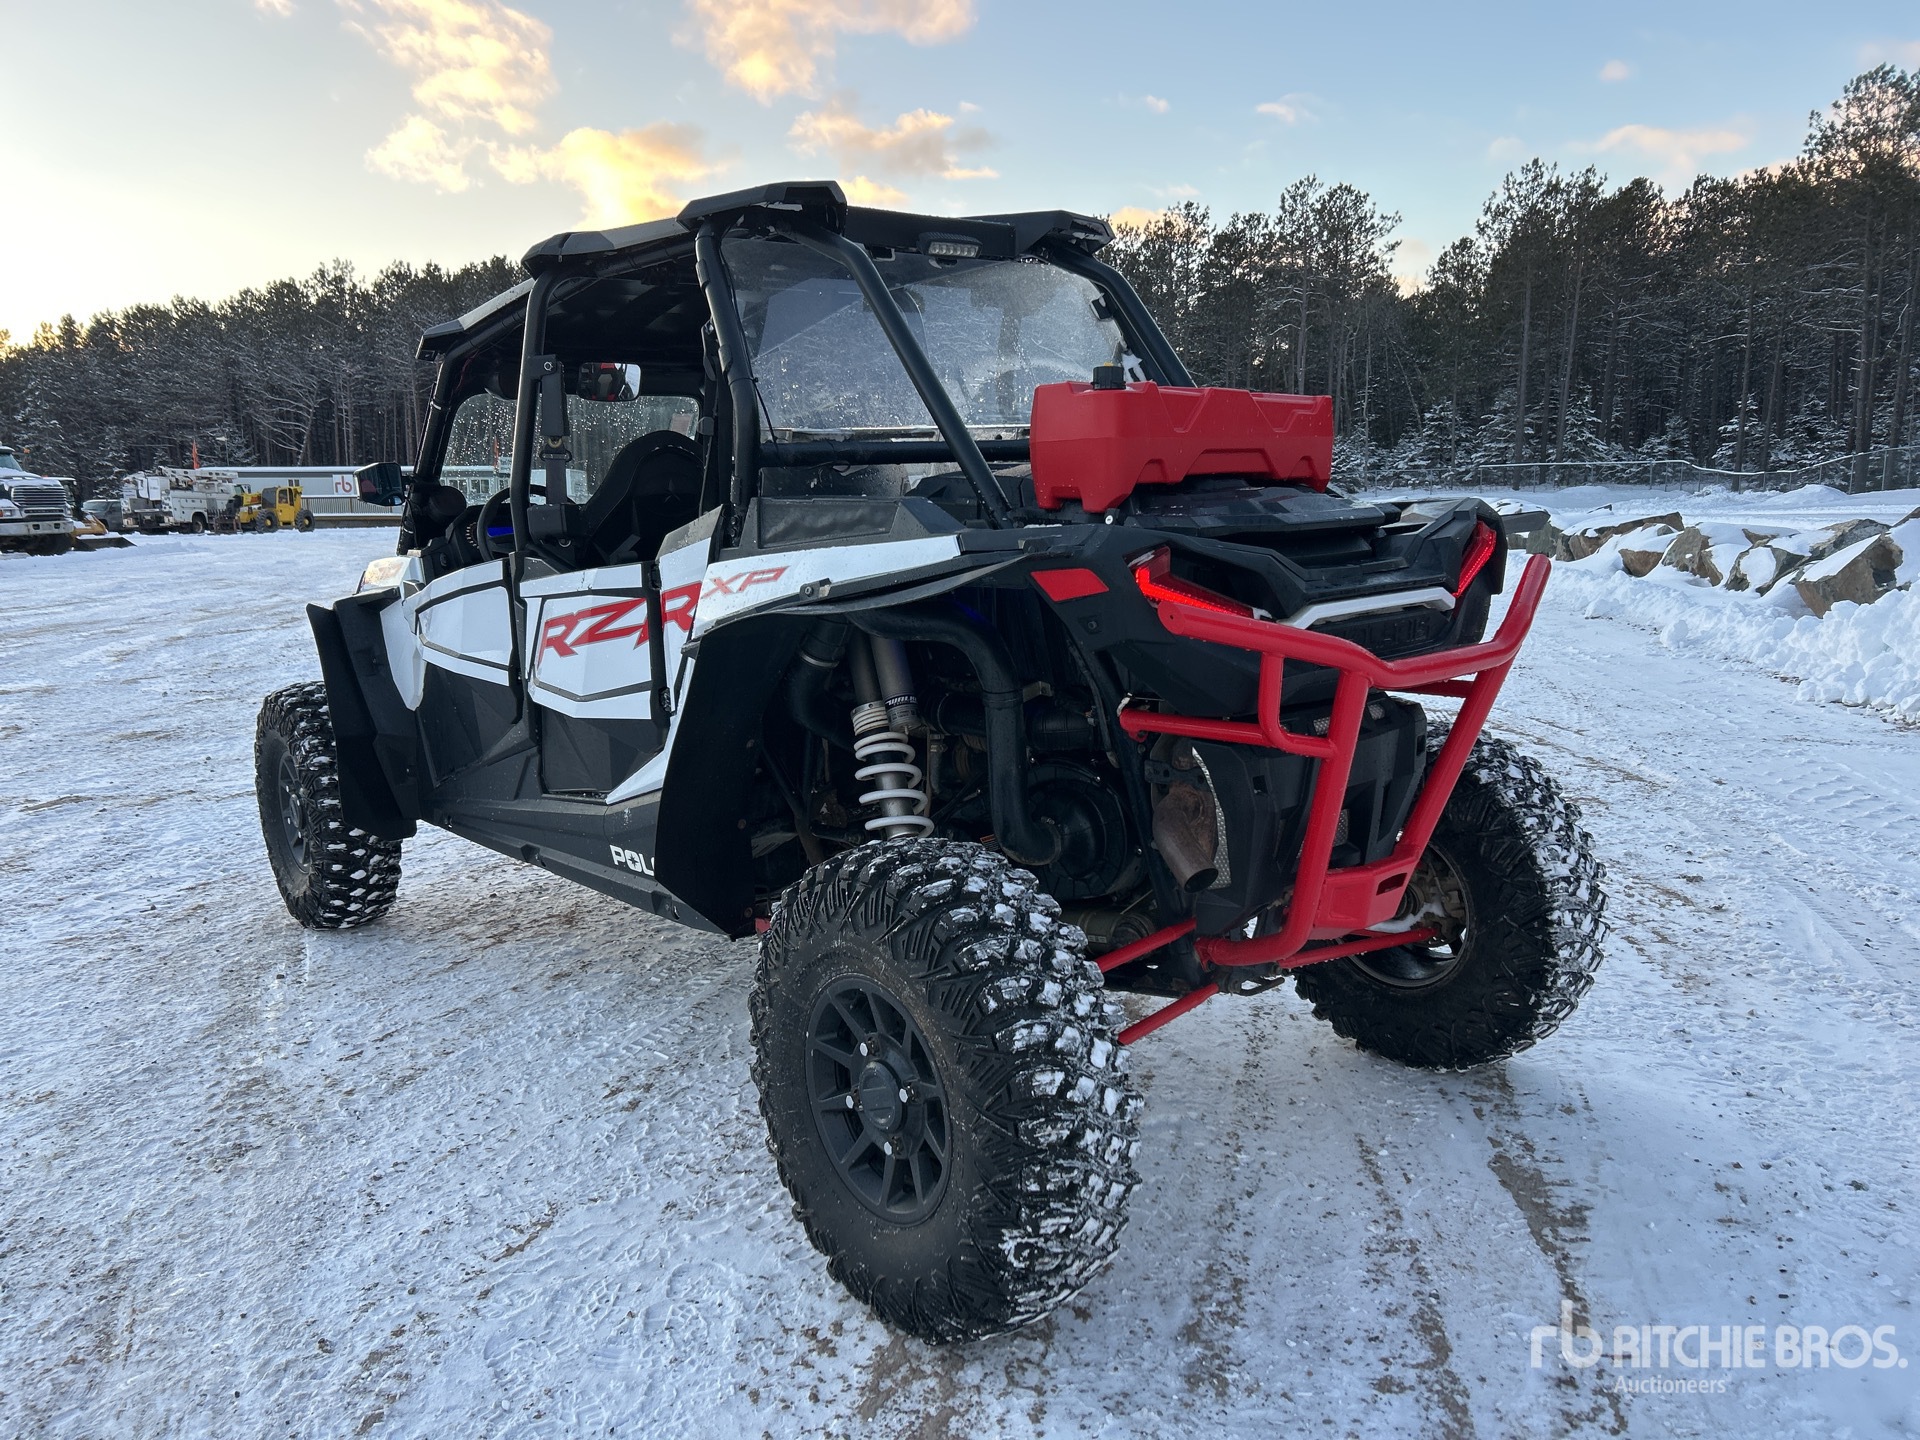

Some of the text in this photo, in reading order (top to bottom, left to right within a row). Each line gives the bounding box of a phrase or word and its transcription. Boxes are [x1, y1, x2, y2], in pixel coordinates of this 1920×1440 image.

[335, 475, 352, 493] rb
[537, 565, 790, 666] RZR XP
[609, 844, 655, 877] POL
